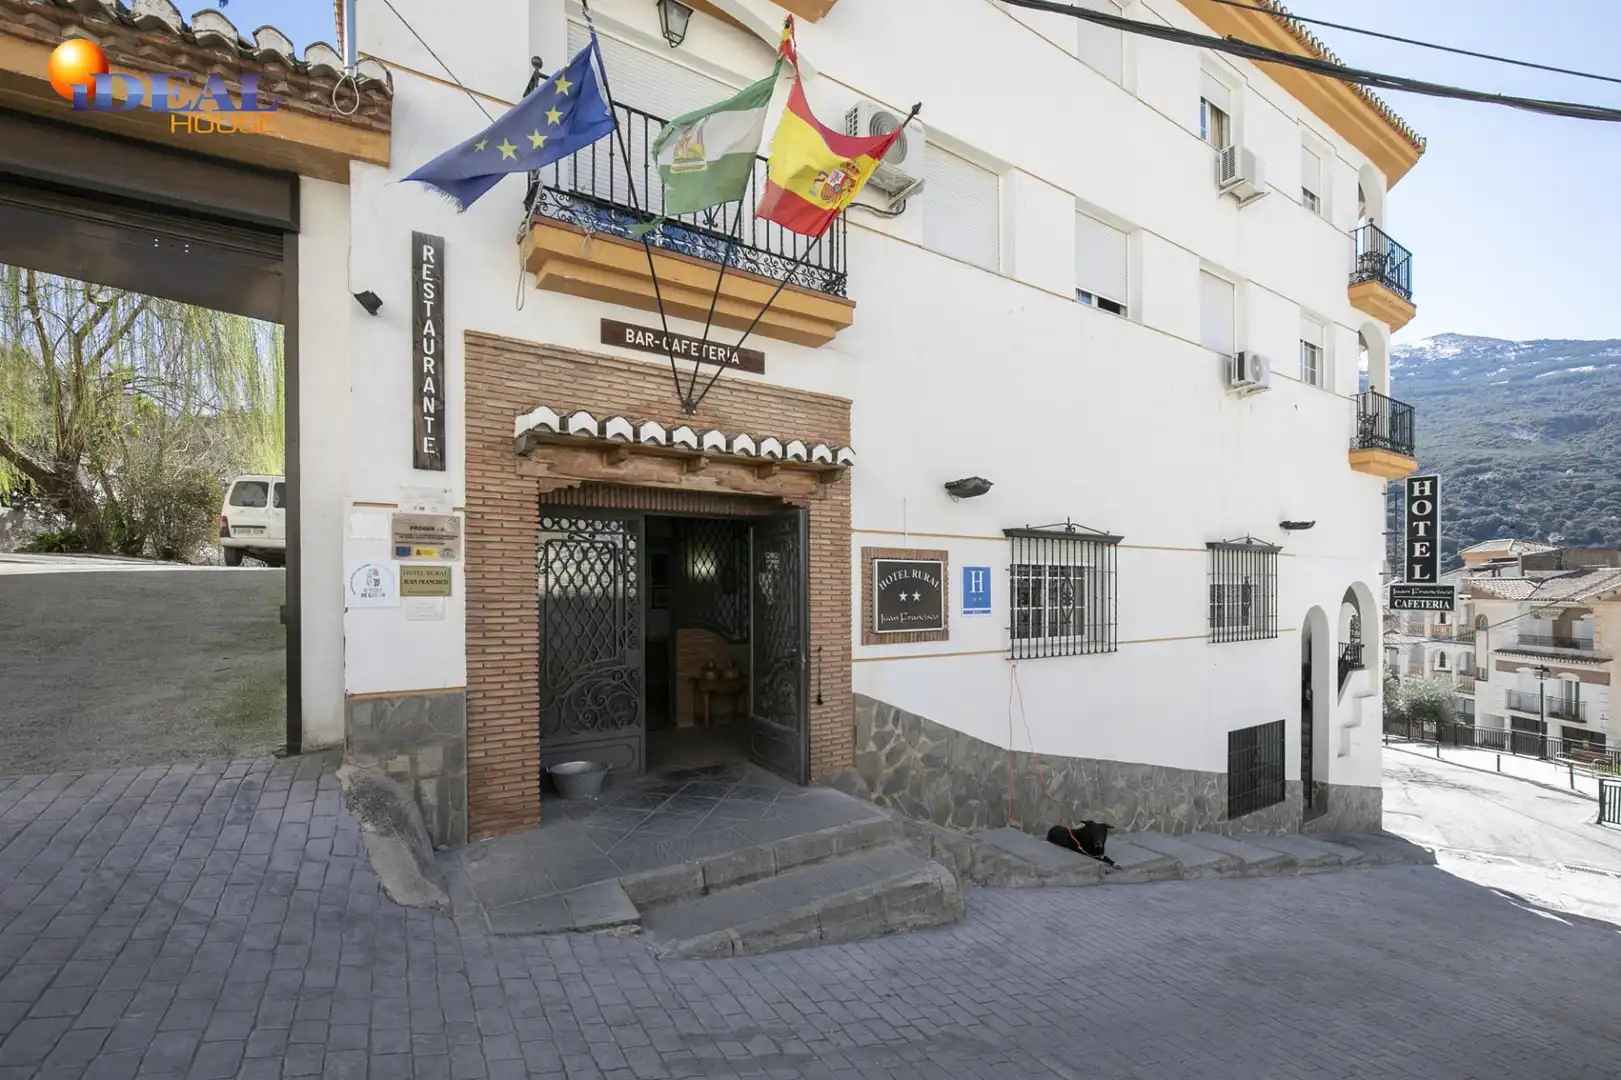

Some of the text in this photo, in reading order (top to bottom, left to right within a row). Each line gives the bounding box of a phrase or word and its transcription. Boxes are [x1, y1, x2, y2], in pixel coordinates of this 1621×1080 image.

[422, 244, 436, 454] RESTAURANTE
[1411, 480, 1433, 580] HOTEL
[878, 569, 940, 591] HOTEL RURAL
[969, 570, 985, 594] H
[1394, 599, 1450, 609] CAFETERIA
[880, 611, 939, 624] Juan Francisco
